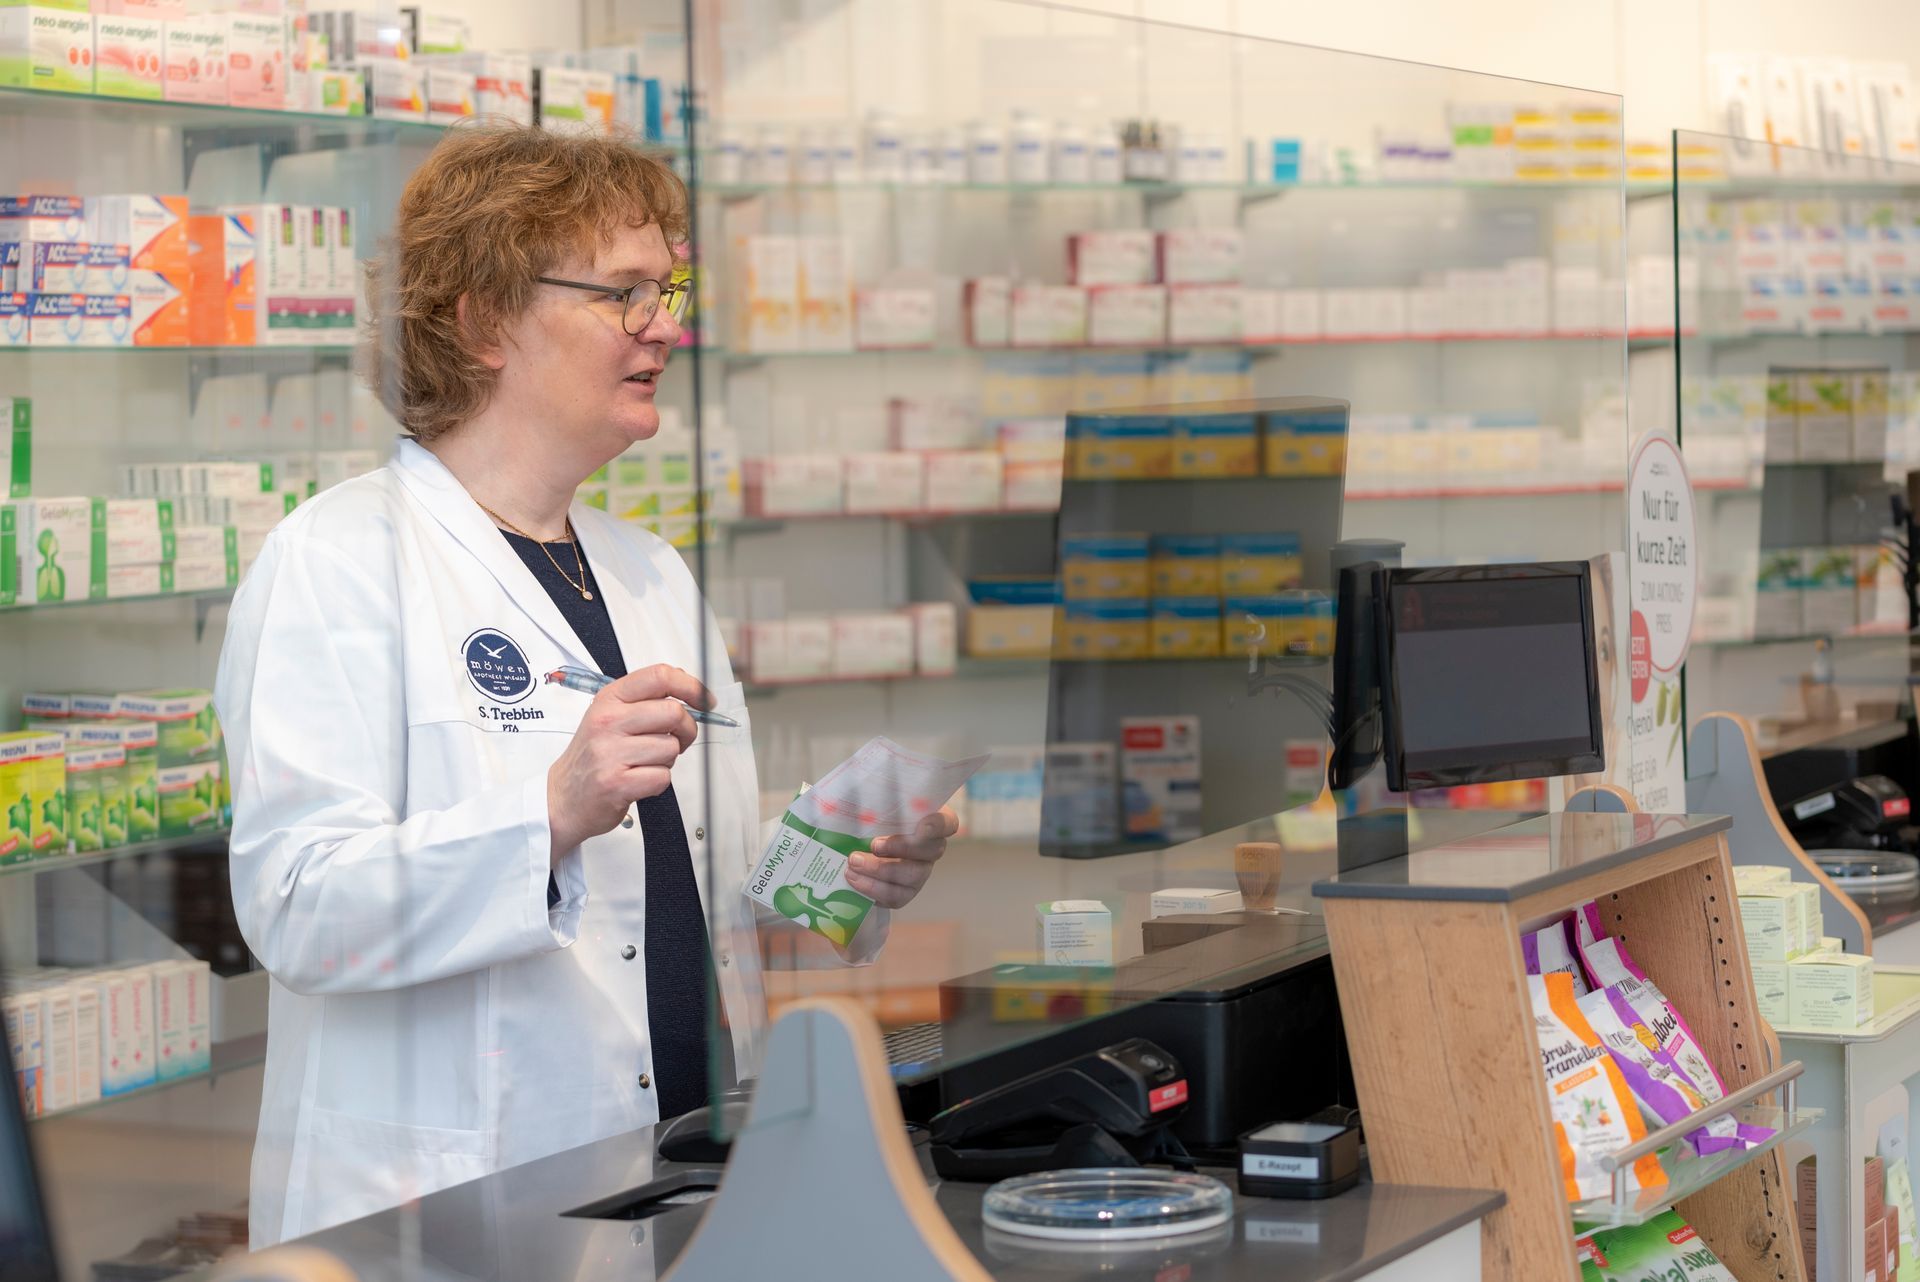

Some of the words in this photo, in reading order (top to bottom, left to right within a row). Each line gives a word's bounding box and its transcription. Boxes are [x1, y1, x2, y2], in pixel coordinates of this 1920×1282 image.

[1642, 490, 1661, 521] Nur
[1664, 490, 1680, 522] für
[1637, 532, 1665, 565] kurze
[1667, 535, 1687, 567] Zeit
[471, 660, 525, 674] möwen
[478, 706, 490, 719] S.
[491, 707, 544, 720] Trebbin
[502, 724, 519, 733] PTA
[789, 840, 804, 858] forte
[752, 834, 795, 895] GeloMyrtol
[1259, 1160, 1302, 1172] E-Rezept
